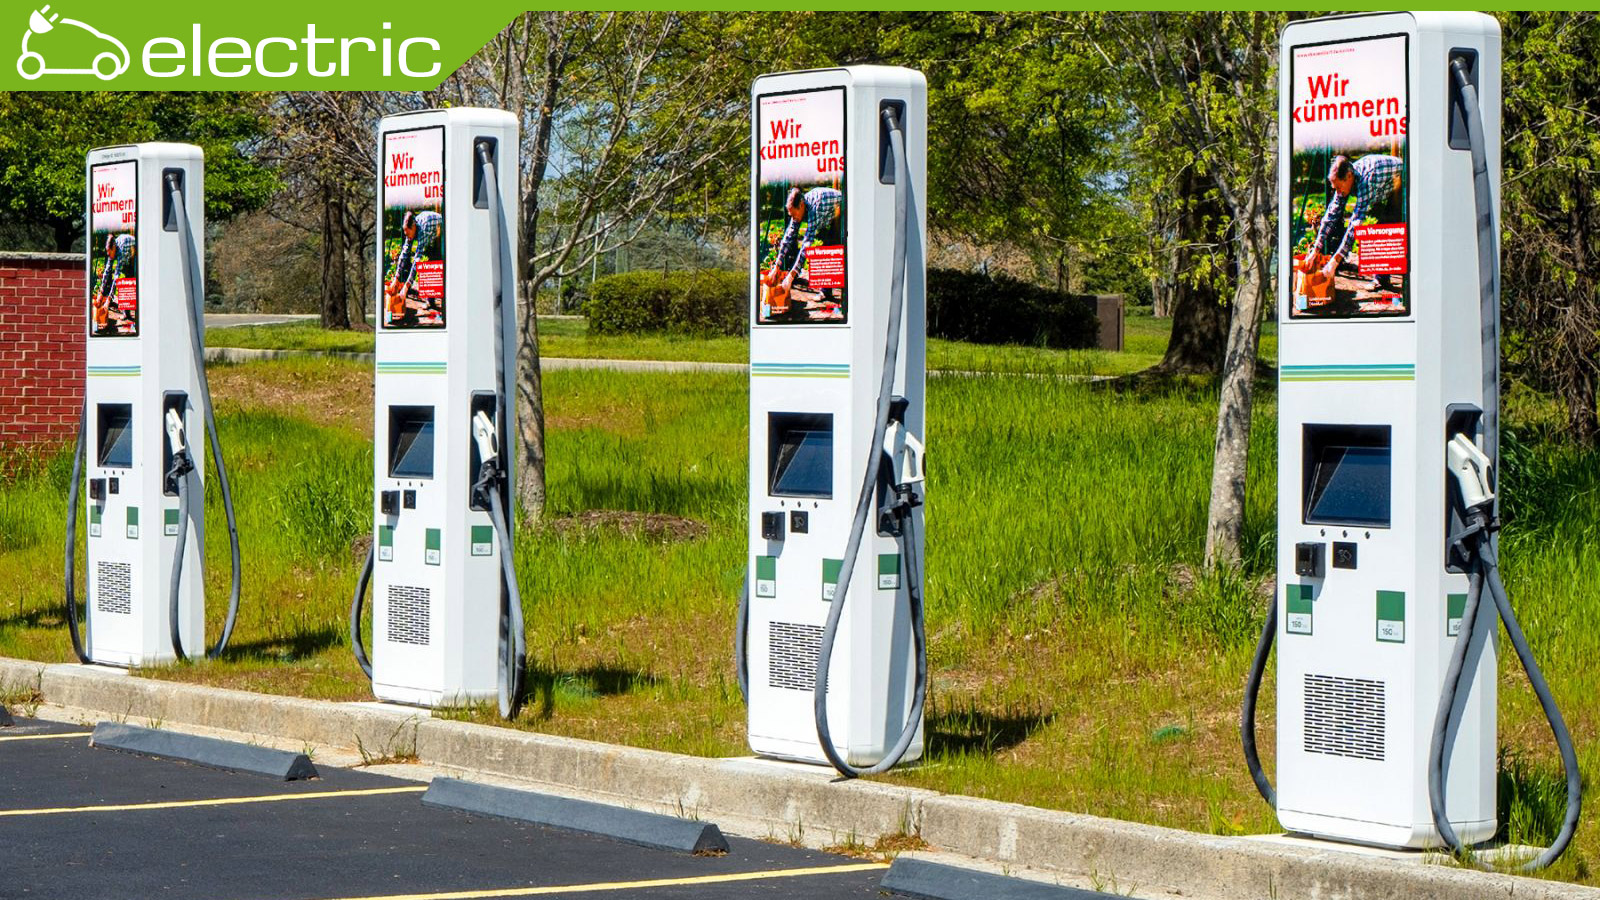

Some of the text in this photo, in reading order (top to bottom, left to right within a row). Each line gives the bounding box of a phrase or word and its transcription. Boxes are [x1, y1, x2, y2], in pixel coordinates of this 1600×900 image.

[1307, 73, 1350, 99] Wir
[770, 118, 802, 140] Wir
[391, 152, 414, 170] Wir
[97, 183, 115, 199] Wir
